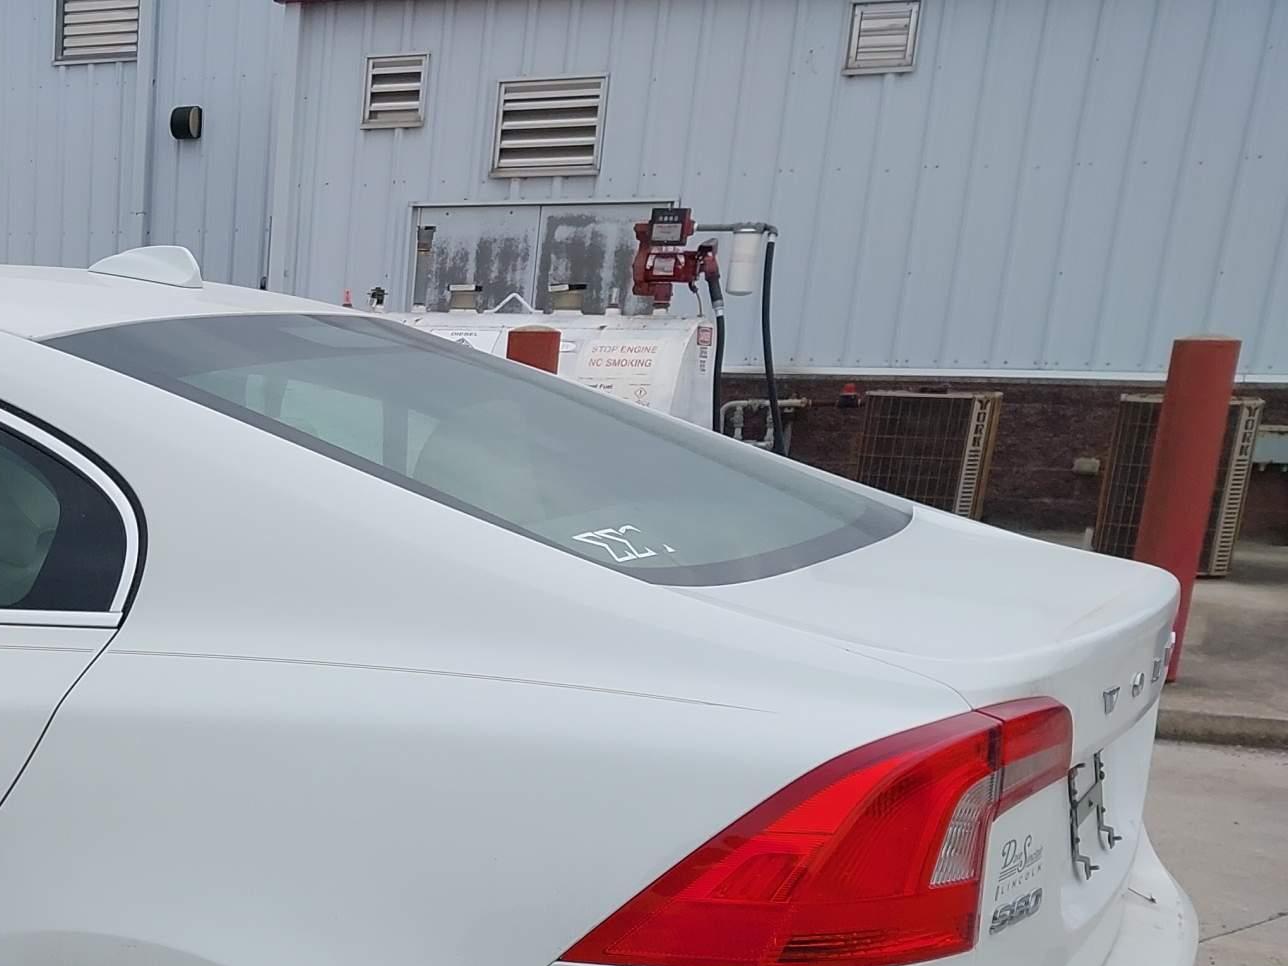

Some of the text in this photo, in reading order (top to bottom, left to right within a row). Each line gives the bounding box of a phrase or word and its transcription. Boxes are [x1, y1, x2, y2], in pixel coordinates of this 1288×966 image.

[589, 358, 652, 367] NO SMOKING
[592, 345, 657, 354] STOP ENGINE
[972, 399, 990, 447] YORK
[1239, 406, 1258, 456] YORK
